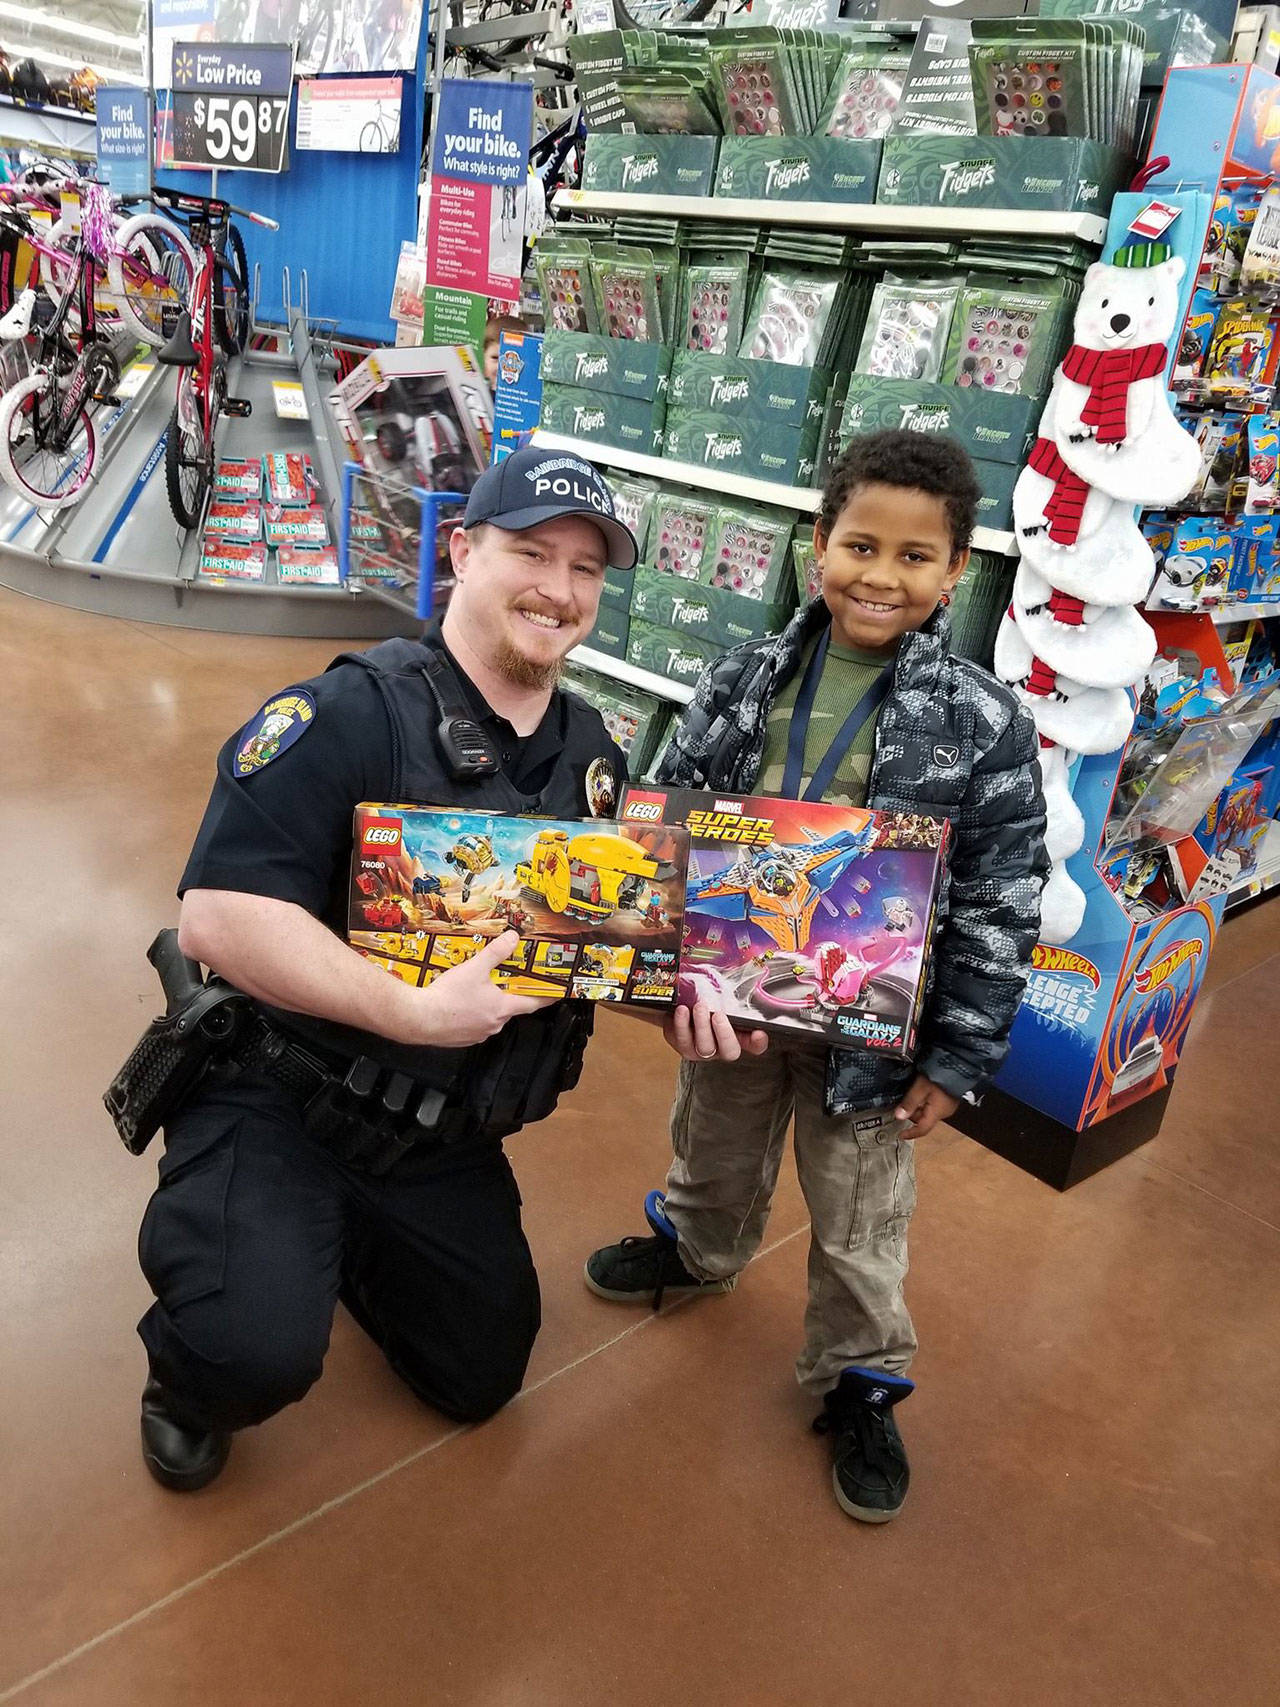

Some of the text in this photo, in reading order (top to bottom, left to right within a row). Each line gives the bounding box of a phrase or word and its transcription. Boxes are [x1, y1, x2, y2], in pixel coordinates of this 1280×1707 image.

[197, 54, 221, 65] Everyday
[614, 57, 623, 66] KIT
[197, 64, 261, 86] Low Price
[905, 93, 944, 103] FIDGETS
[112, 104, 133, 122] Find
[469, 107, 502, 132] Find
[612, 108, 626, 120] CAPS
[899, 117, 915, 127] KIT
[101, 123, 145, 142] your bike.
[101, 143, 114, 153] What
[126, 144, 131, 153] is
[131, 143, 145, 156] right?
[444, 132, 521, 158] your bike.
[443, 156, 520, 180] What style is right?
[622, 155, 659, 189] Fidgets
[765, 159, 810, 195] Fidgets
[440, 184, 475, 197] Multi-Use
[939, 161, 995, 202] Fidgets
[440, 206, 463, 215] everyday
[435, 291, 472, 306] Mountain
[434, 305, 468, 317] For trails and
[434, 312, 467, 325] casual riding
[575, 352, 609, 383] Fidgets
[710, 375, 749, 407] Fidgets
[573, 406, 608, 434] Fidgets
[900, 404, 950, 433] Fidgets
[704, 432, 742, 463] Fidgets
[524, 457, 592, 481] BAINBRIDGE
[535, 478, 609, 515] POLICE
[671, 597, 709, 624] Fidgets
[626, 803, 660, 819] LEGO
[714, 800, 743, 814] MARVEL
[686, 810, 775, 832] SUPER
[365, 829, 398, 843] LEGO
[690, 823, 776, 847] EROES
[361, 860, 386, 869] 76080
[632, 986, 674, 997] SUPER
[837, 1015, 901, 1035] GUARDIANS
[849, 1027, 899, 1042] GALAXY
[893, 1037, 902, 1047] 2
